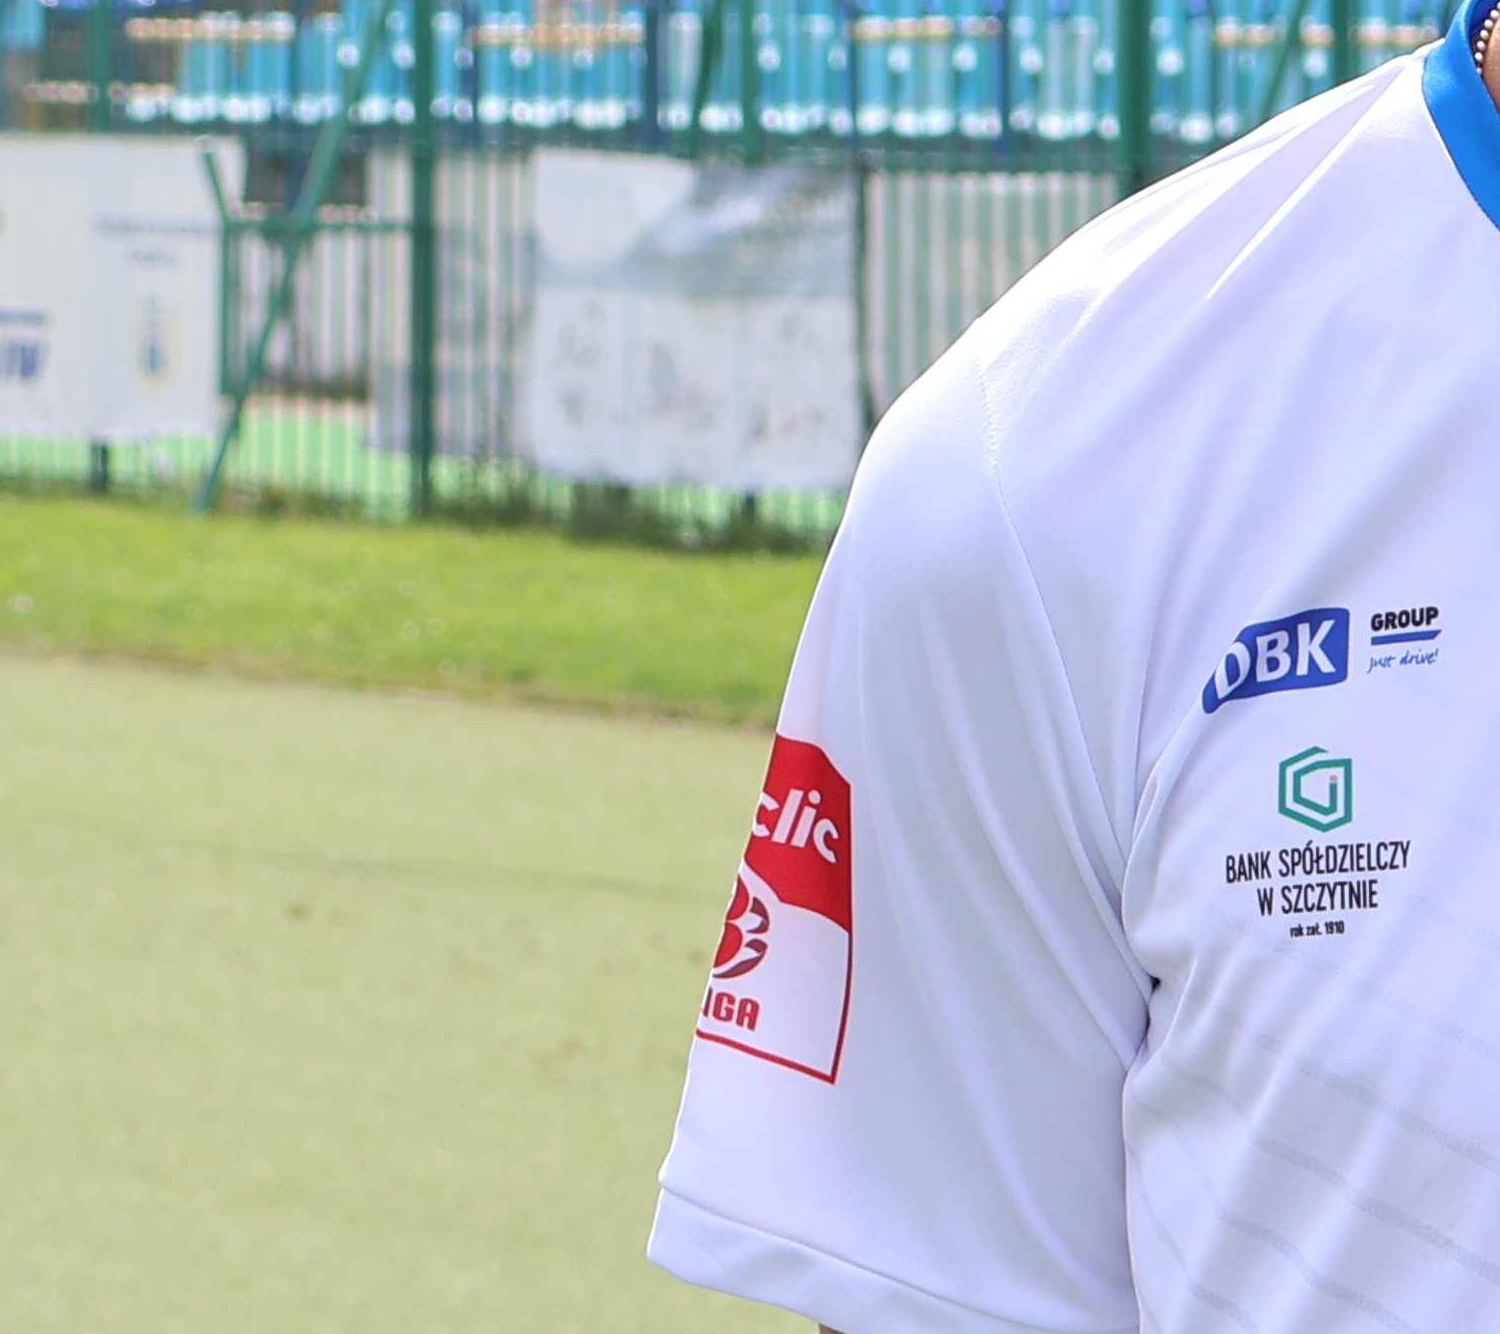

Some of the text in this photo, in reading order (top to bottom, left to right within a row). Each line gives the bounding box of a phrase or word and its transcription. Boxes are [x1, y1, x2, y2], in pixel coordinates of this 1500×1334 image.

[1370, 606, 1439, 632] GROUP
[1214, 619, 1337, 699] DBK
[1225, 839, 1411, 884] BANK SPÓŁDZIELCZY
[1257, 879, 1378, 917] W SZCZYTNIE
